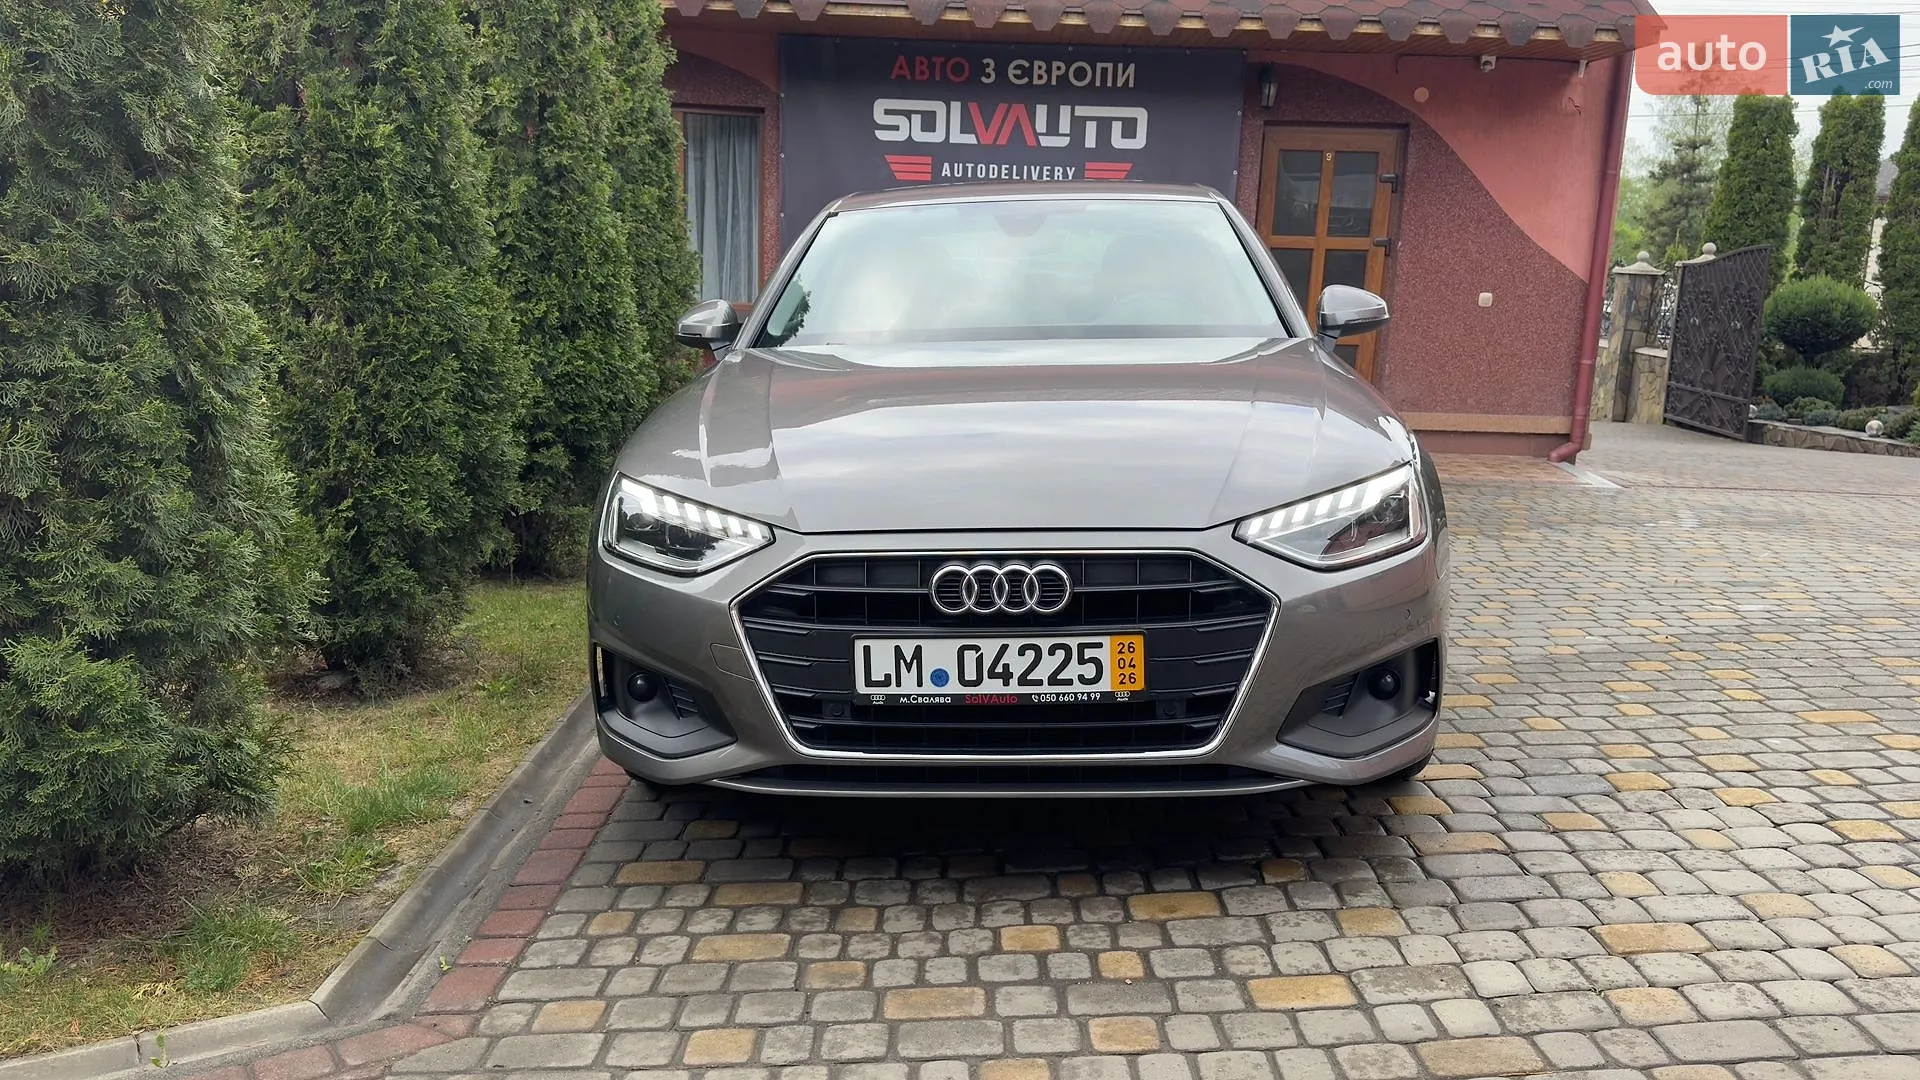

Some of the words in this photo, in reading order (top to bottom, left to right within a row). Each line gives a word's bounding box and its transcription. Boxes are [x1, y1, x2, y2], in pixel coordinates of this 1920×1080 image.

[890, 55, 970, 82] АВТО
[1007, 59, 1136, 88] ЄВРОПИ
[873, 98, 1148, 150] SOLVAUTO
[1326, 152, 1332, 161] 9
[941, 162, 1076, 181] AUTODELIVERY
[1117, 641, 1136, 655] 26
[862, 644, 924, 688] LM
[956, 641, 1104, 688] 04225
[1117, 657, 1136, 670] 04
[1118, 672, 1137, 685] 26
[1040, 693, 1057, 702] 050
[1058, 693, 1075, 702] 660
[1076, 692, 1088, 701] 94
[1089, 692, 1101, 701] 99
